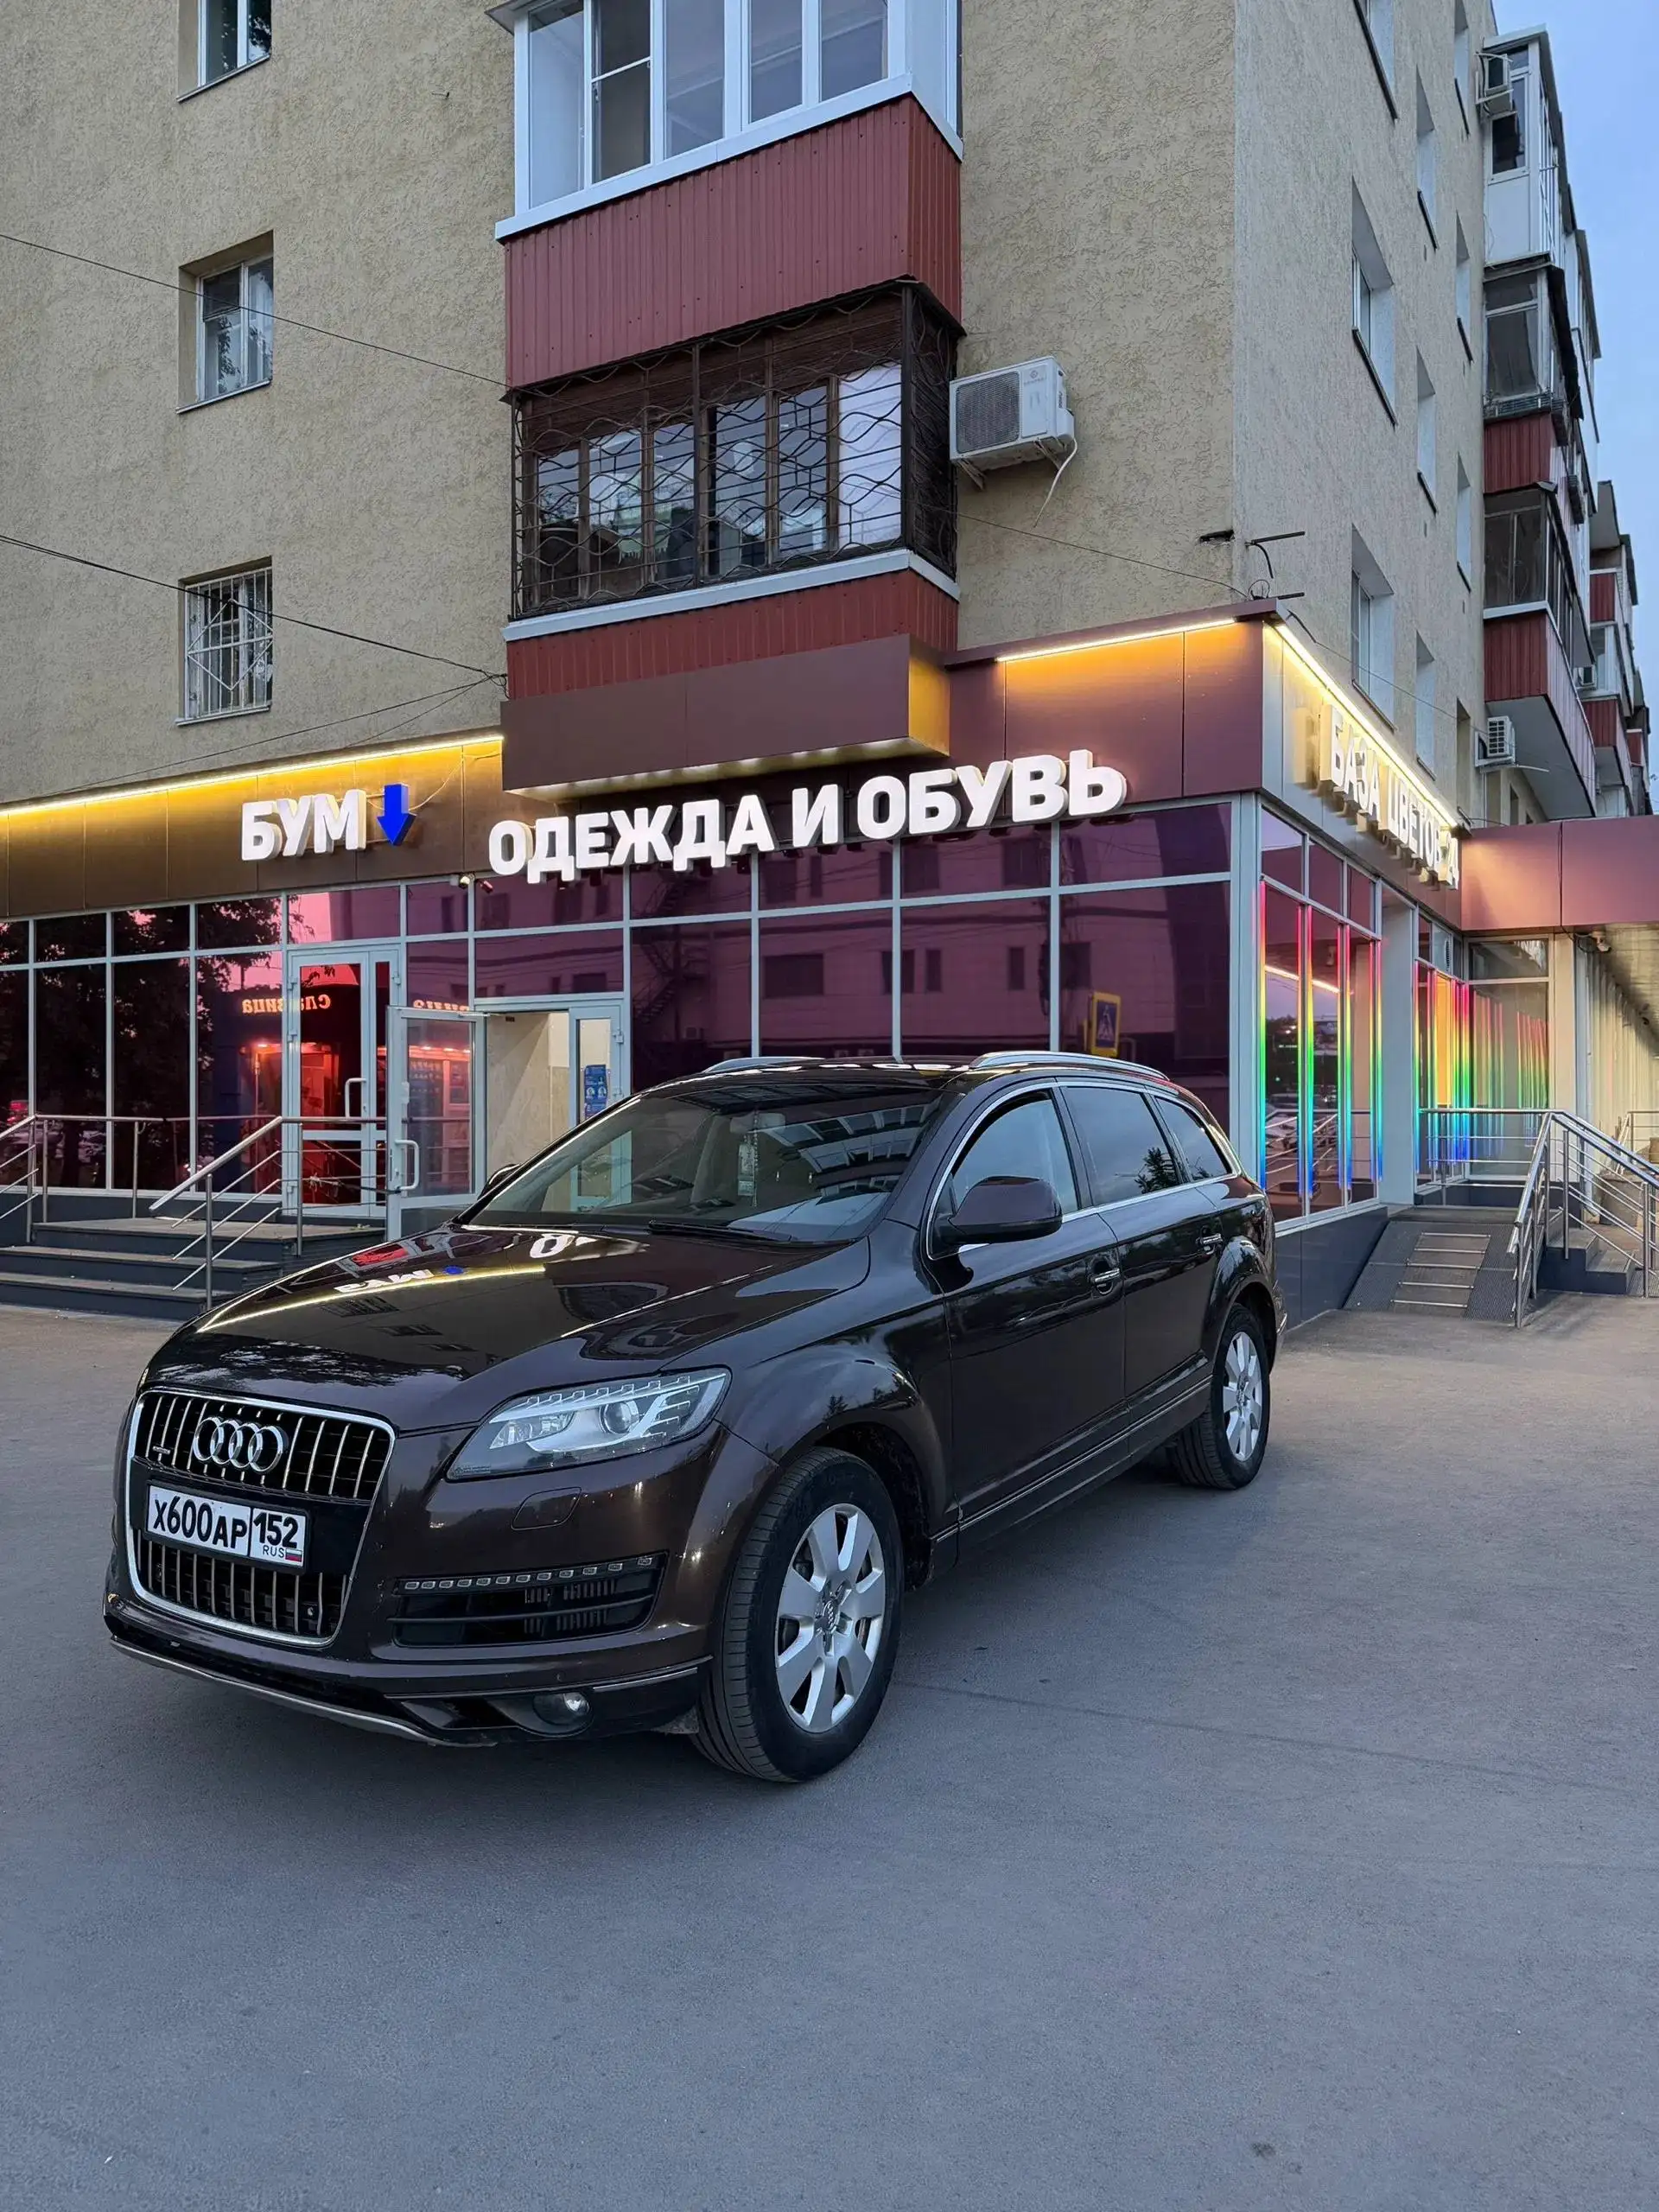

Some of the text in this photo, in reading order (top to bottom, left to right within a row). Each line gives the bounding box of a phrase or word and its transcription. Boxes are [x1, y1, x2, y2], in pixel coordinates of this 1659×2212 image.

[242, 790, 363, 861] БУМ
[488, 749, 1126, 883] ОДЕЖДА И ОБУВЬ
[1327, 704, 1381, 819] БАЗА
[1386, 765, 1441, 876] ЦВЕТОВ
[153, 1496, 299, 1548] Х600АР 152
[262, 1545, 285, 1559] RUS
